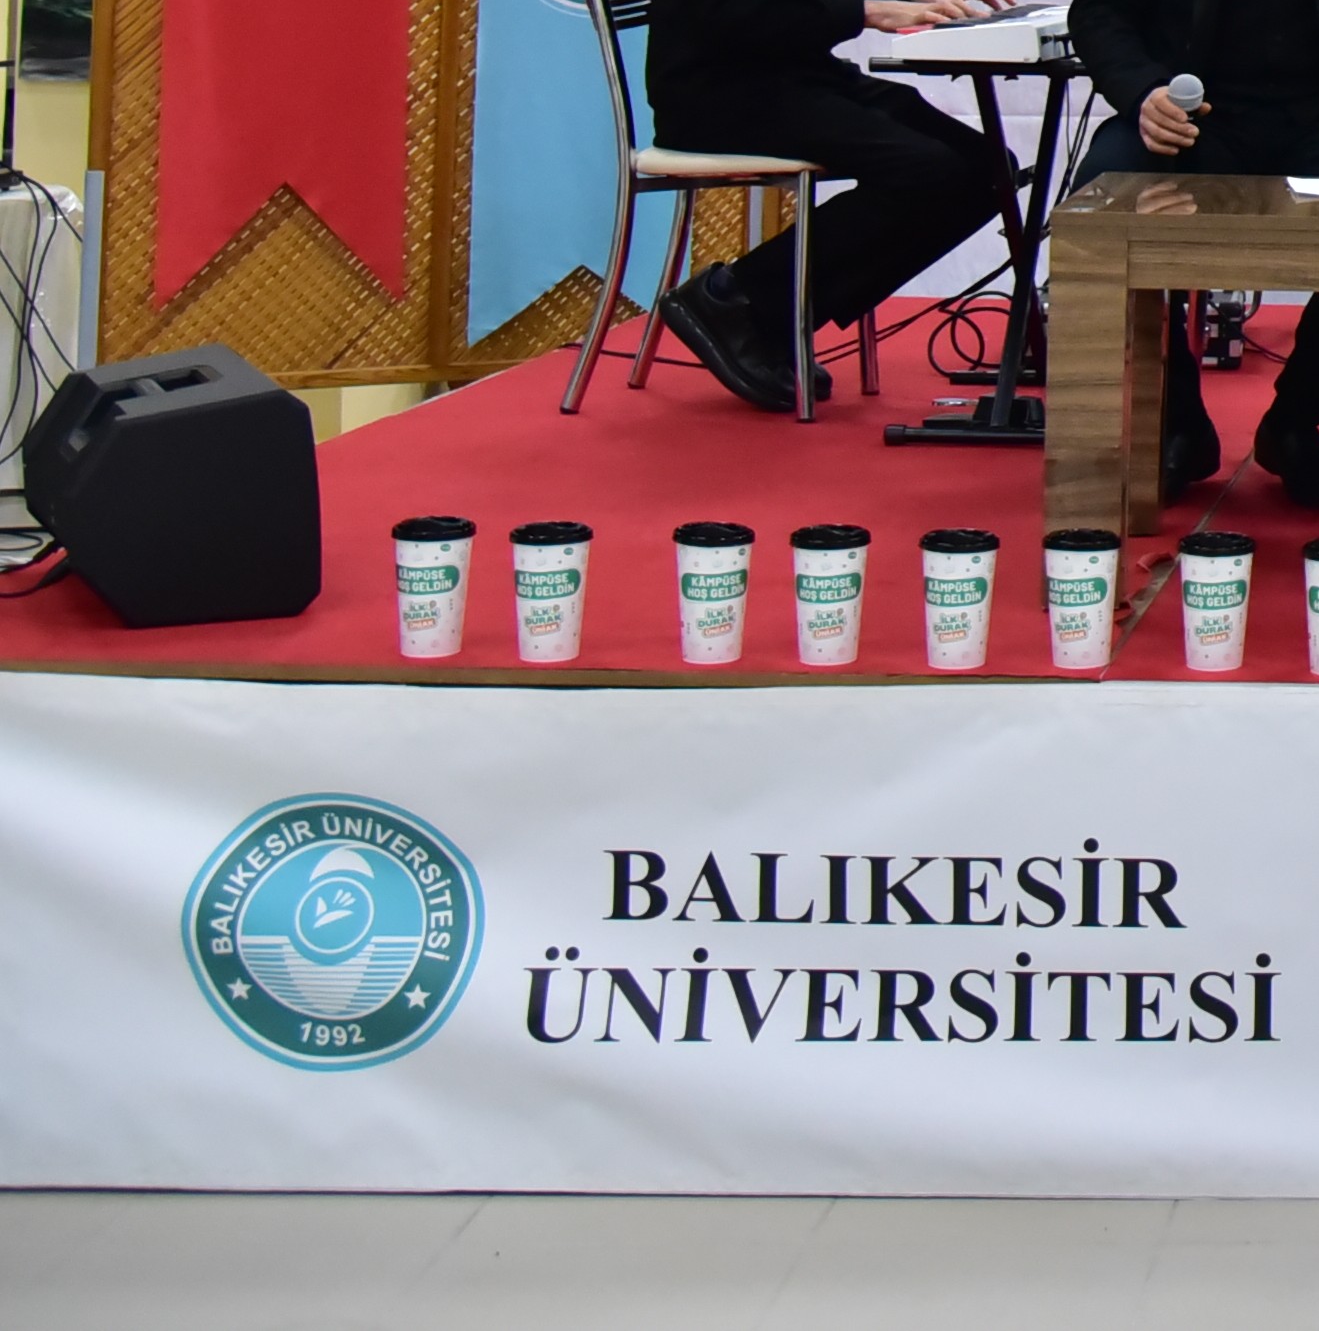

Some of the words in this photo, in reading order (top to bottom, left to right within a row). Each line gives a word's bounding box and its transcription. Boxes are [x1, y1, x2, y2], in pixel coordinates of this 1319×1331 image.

[210, 816, 316, 957] BALIKESİR
[322, 813, 452, 965] ÜNİVERSİTESİ
[602, 838, 1186, 928] BALIKESİR
[298, 1021, 368, 1049] 1992
[523, 946, 1282, 1044] ÜNİVERSİTESİ
